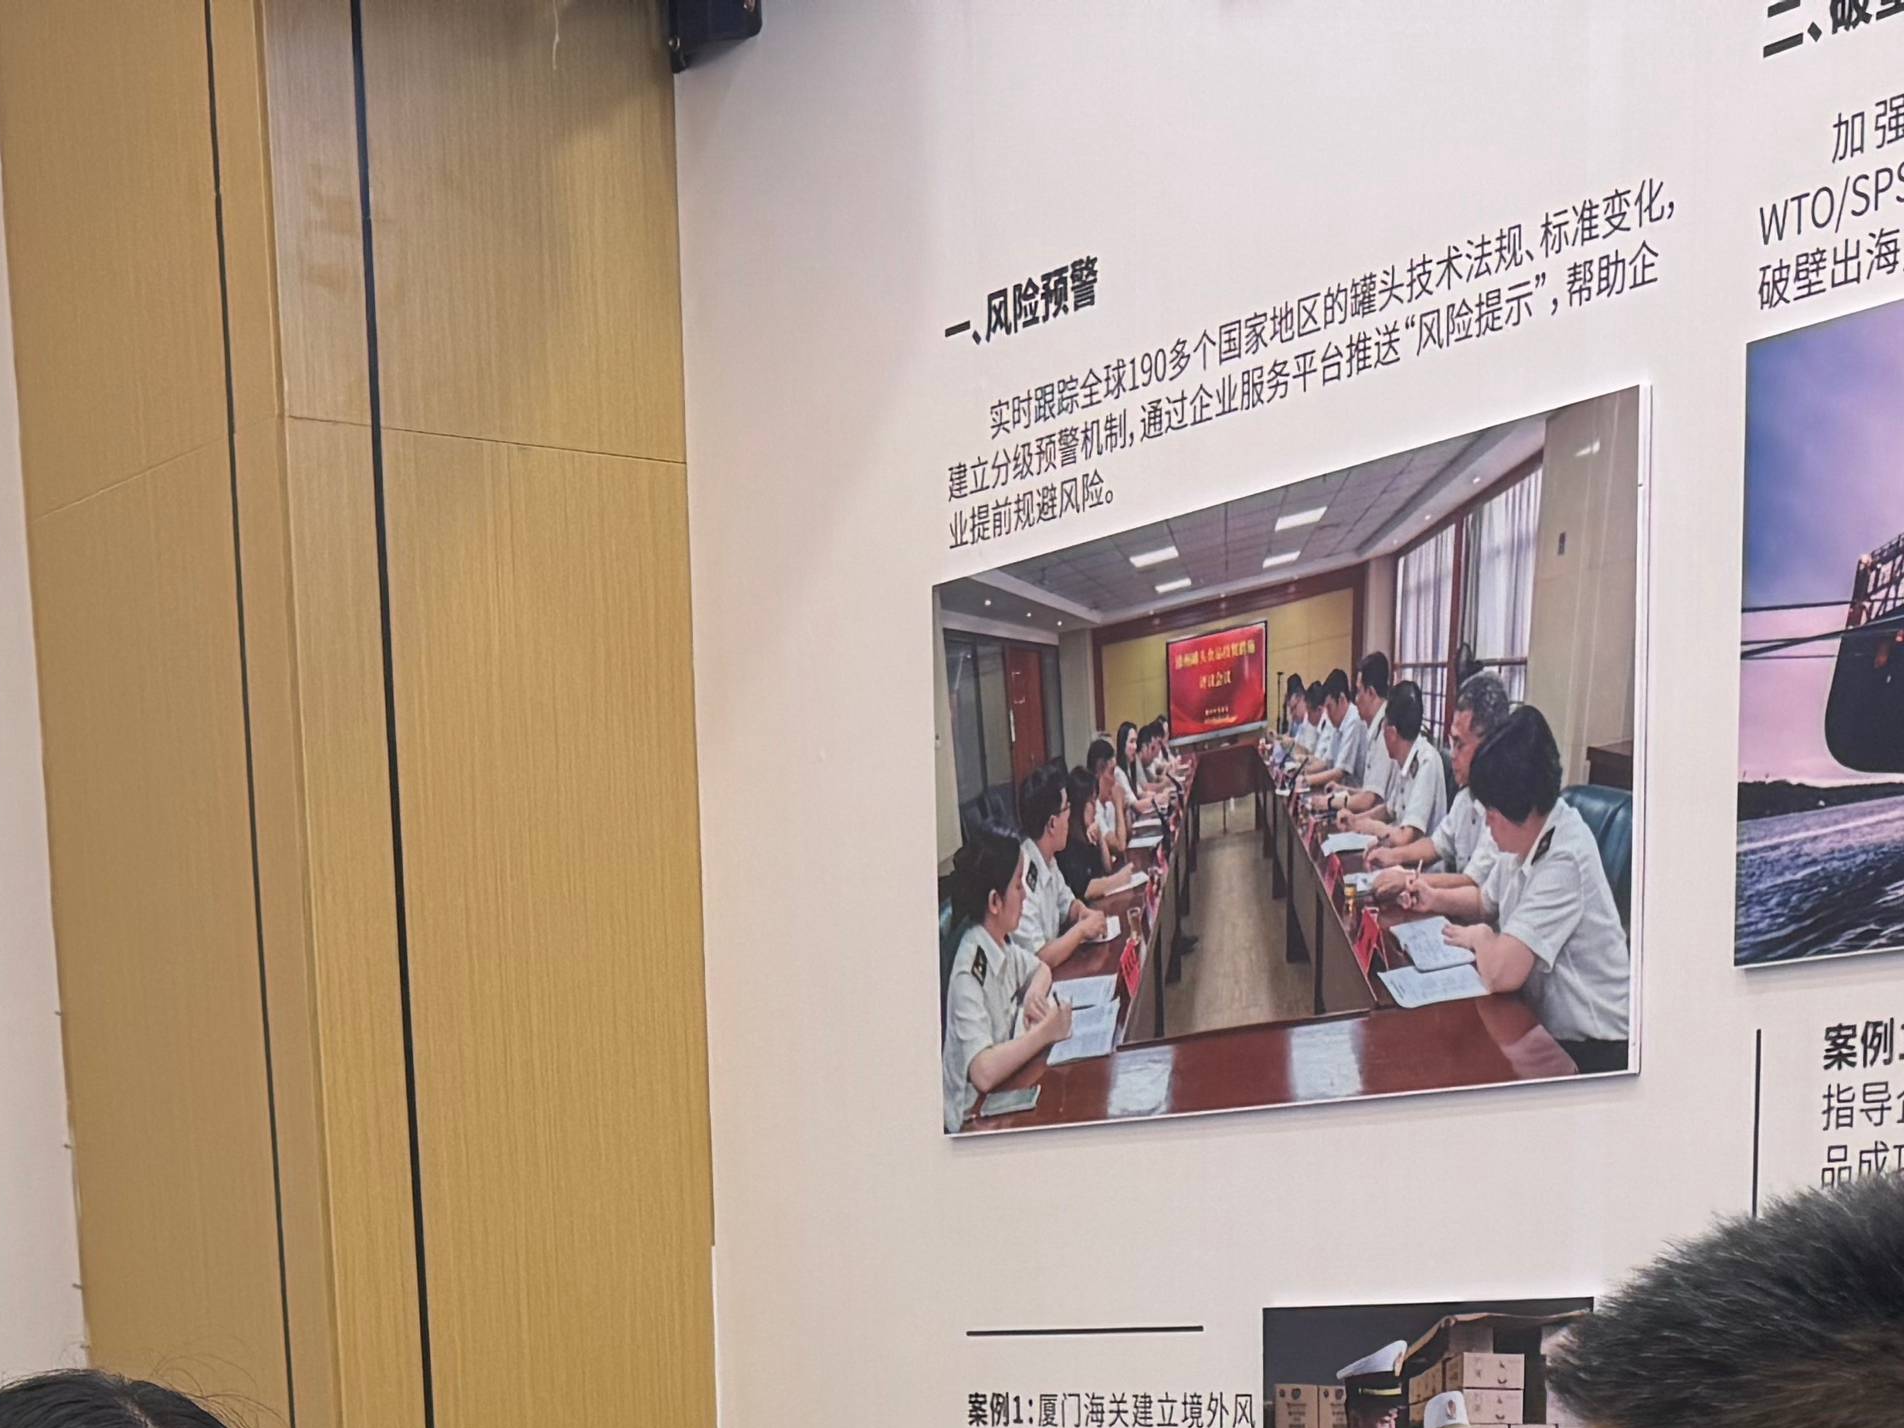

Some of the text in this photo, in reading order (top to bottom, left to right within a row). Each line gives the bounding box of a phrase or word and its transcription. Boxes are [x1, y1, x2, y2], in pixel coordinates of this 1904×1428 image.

[944, 255, 1099, 347] 一、风险预警
[948, 471, 1115, 549] 业提前规避风险。
